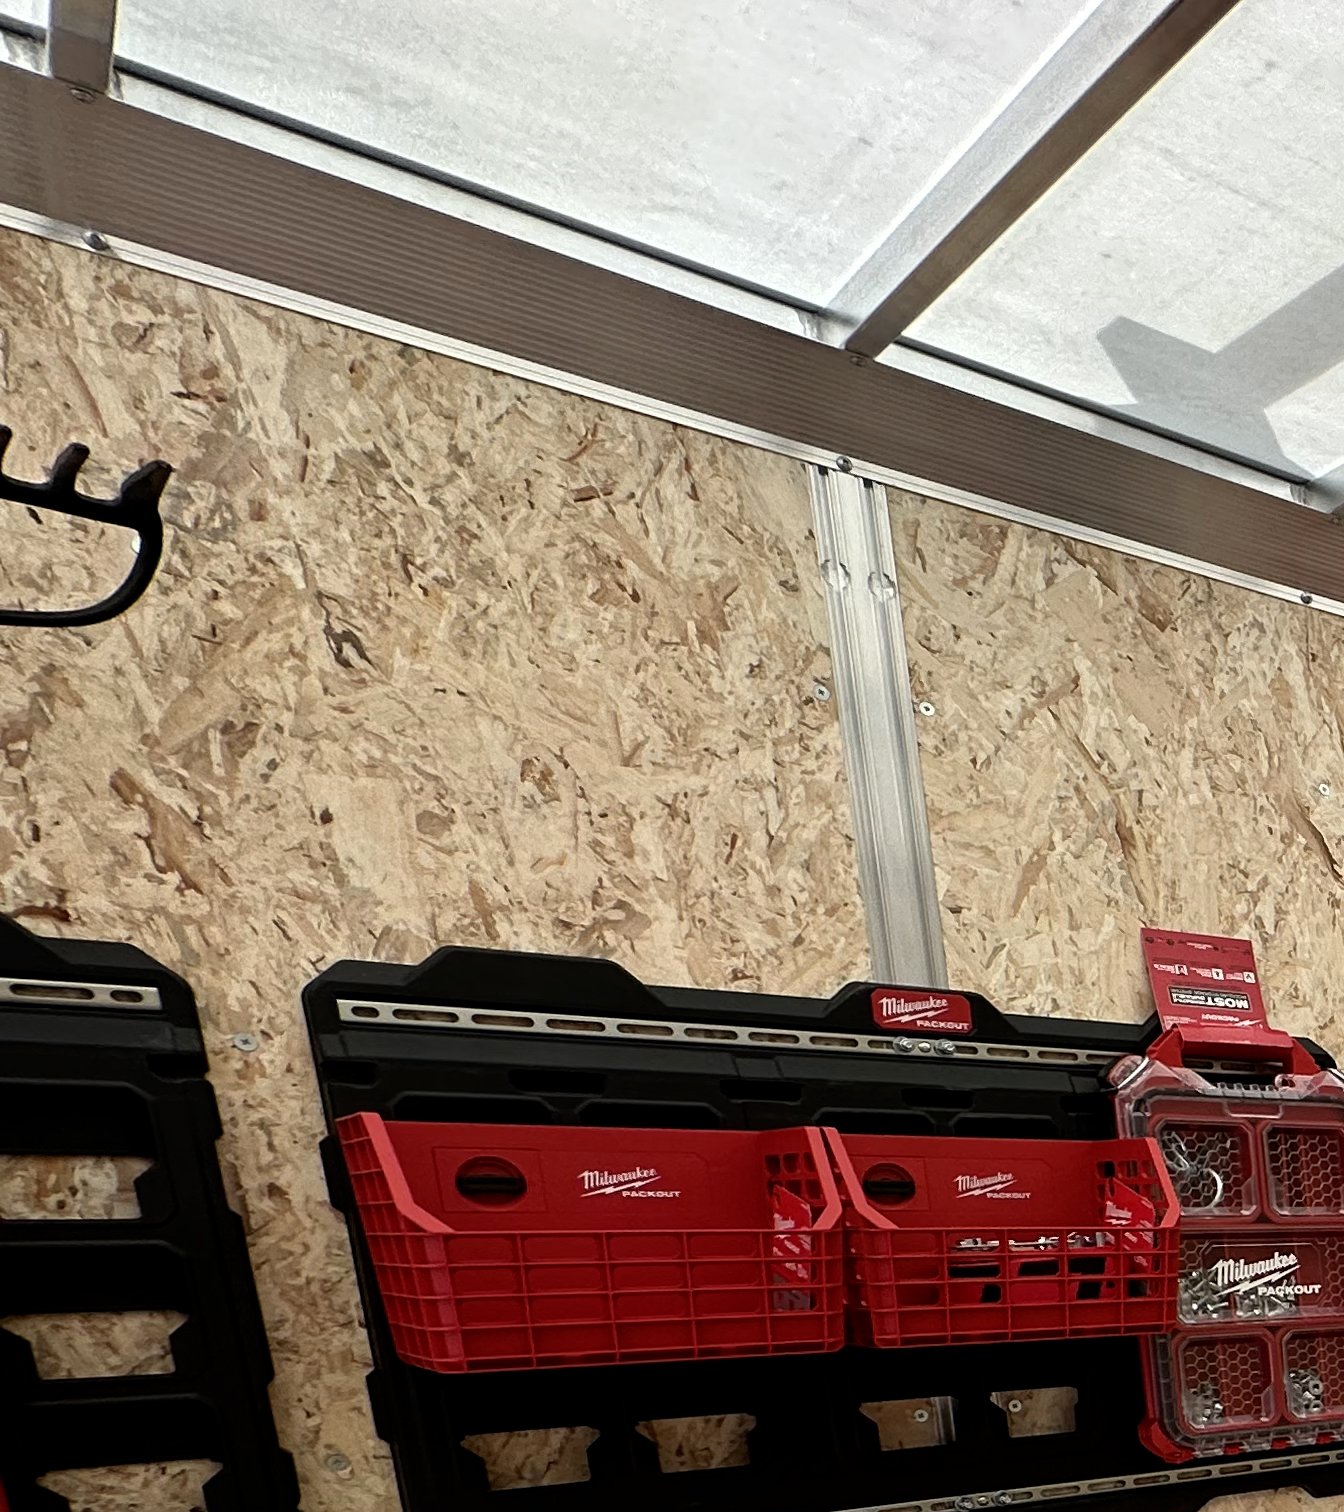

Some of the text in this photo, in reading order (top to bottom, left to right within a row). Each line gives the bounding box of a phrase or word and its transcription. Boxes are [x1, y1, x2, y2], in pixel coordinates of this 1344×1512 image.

[878, 995, 949, 1017] Milwaukee
[916, 1020, 970, 1030] PACKOUT
[577, 1166, 658, 1190] Milwaukee
[953, 1171, 1015, 1192] Milwaukee
[1208, 1251, 1298, 1287] Milwaukee
[1257, 1284, 1322, 1297] PACKOUT
